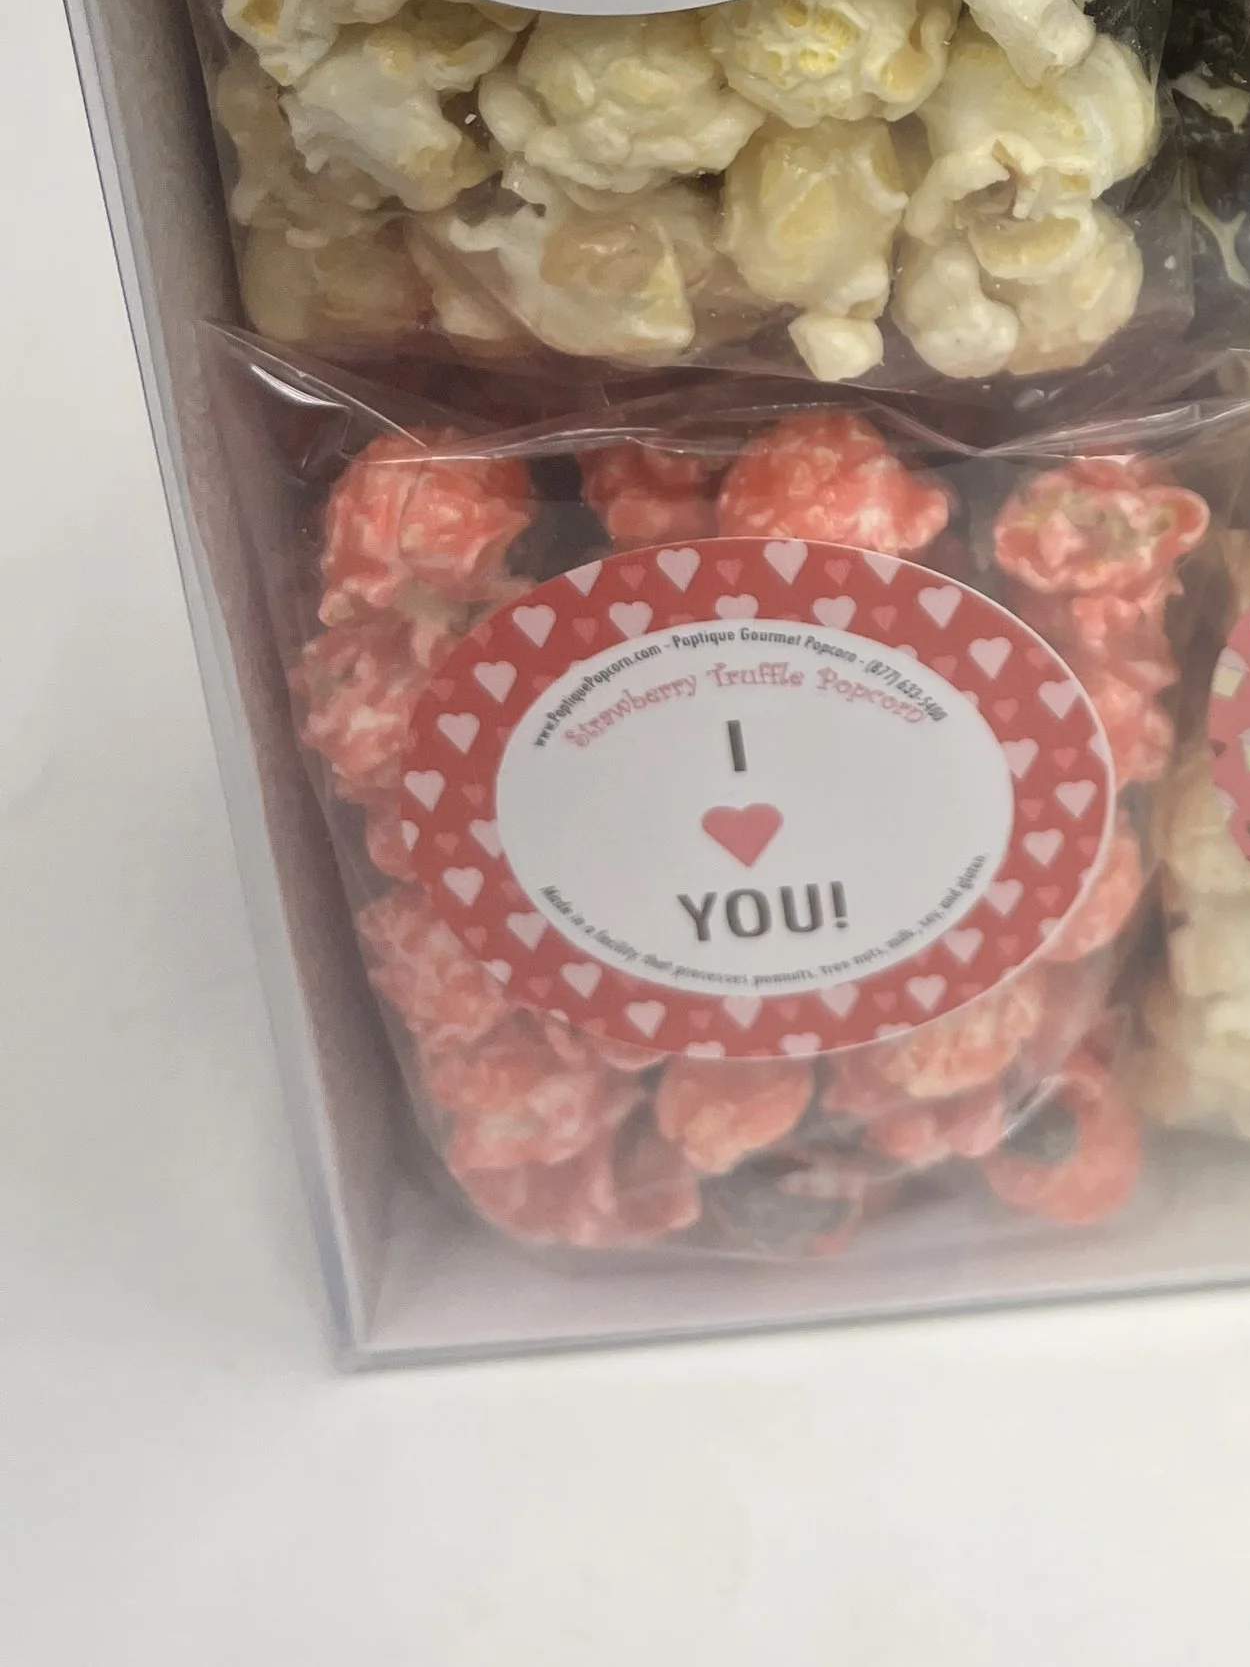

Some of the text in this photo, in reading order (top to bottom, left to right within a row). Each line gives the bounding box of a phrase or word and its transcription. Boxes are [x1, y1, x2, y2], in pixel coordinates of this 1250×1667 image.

[533, 644, 662, 748] www.PoptiquePopcorn.com
[671, 628, 735, 650] Poptique
[740, 627, 802, 646] Gourmet
[804, 635, 858, 662] Popcorn
[865, 659, 903, 686] (877)
[563, 662, 926, 747] Strawberry Truffle Popcorn
[726, 719, 748, 772] I
[676, 880, 849, 942] YOU!
